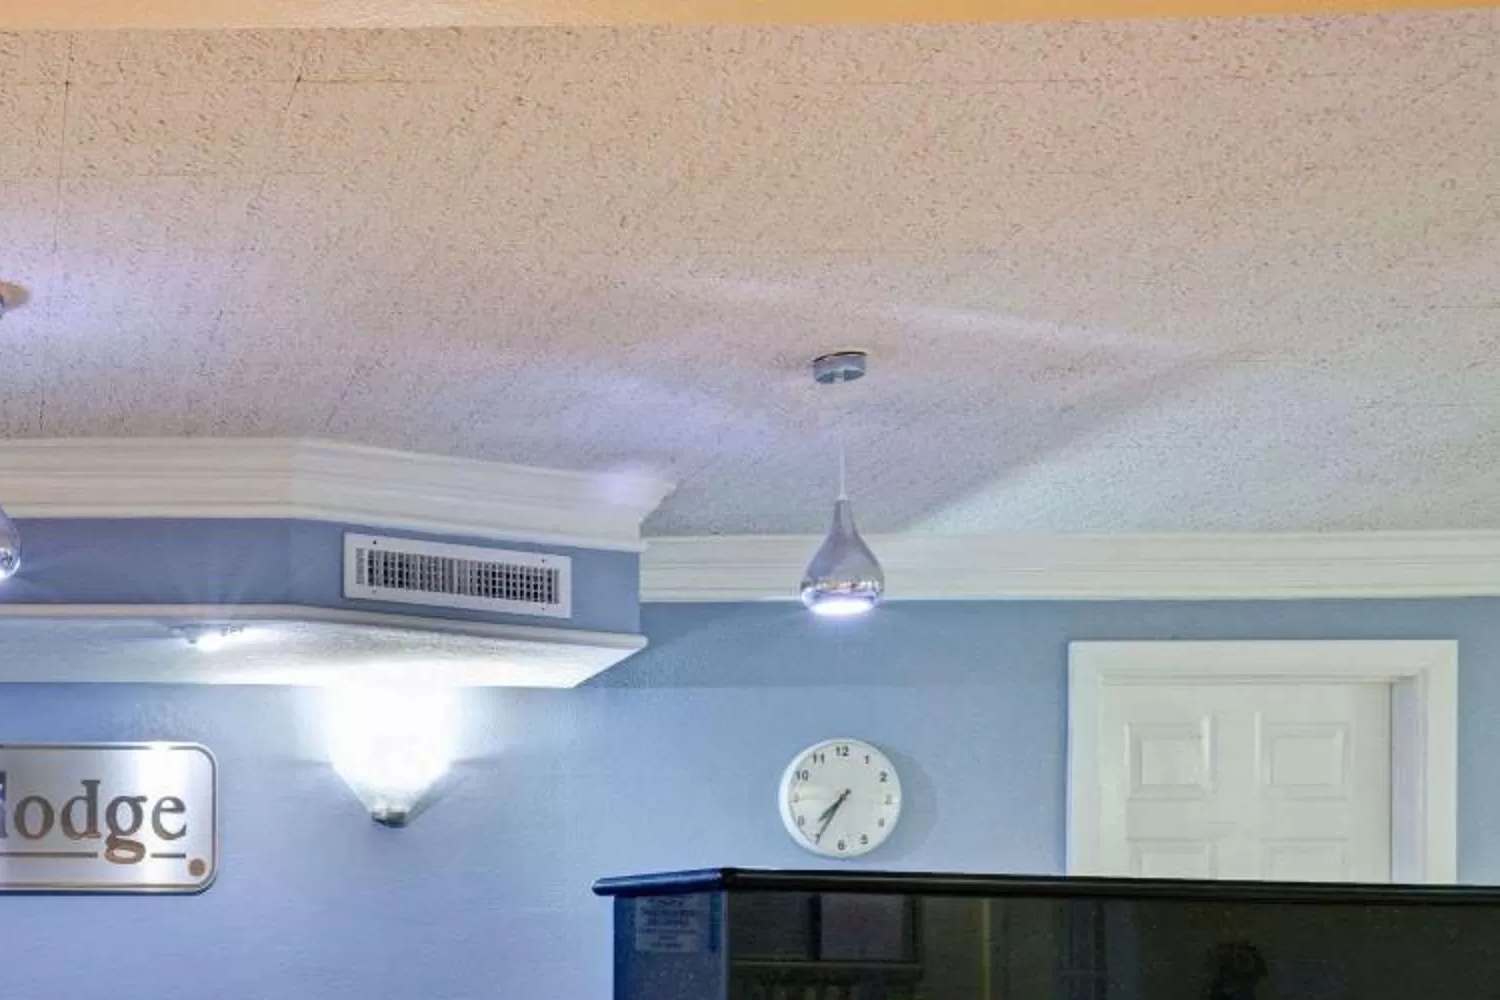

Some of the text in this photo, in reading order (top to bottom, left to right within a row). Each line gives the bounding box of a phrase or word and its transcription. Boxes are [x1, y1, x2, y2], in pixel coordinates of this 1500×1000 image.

[835, 745, 850, 757] 12
[812, 752, 825, 765] 11
[864, 754, 869, 765] 1
[795, 769, 809, 781] 10
[879, 770, 888, 782] 2
